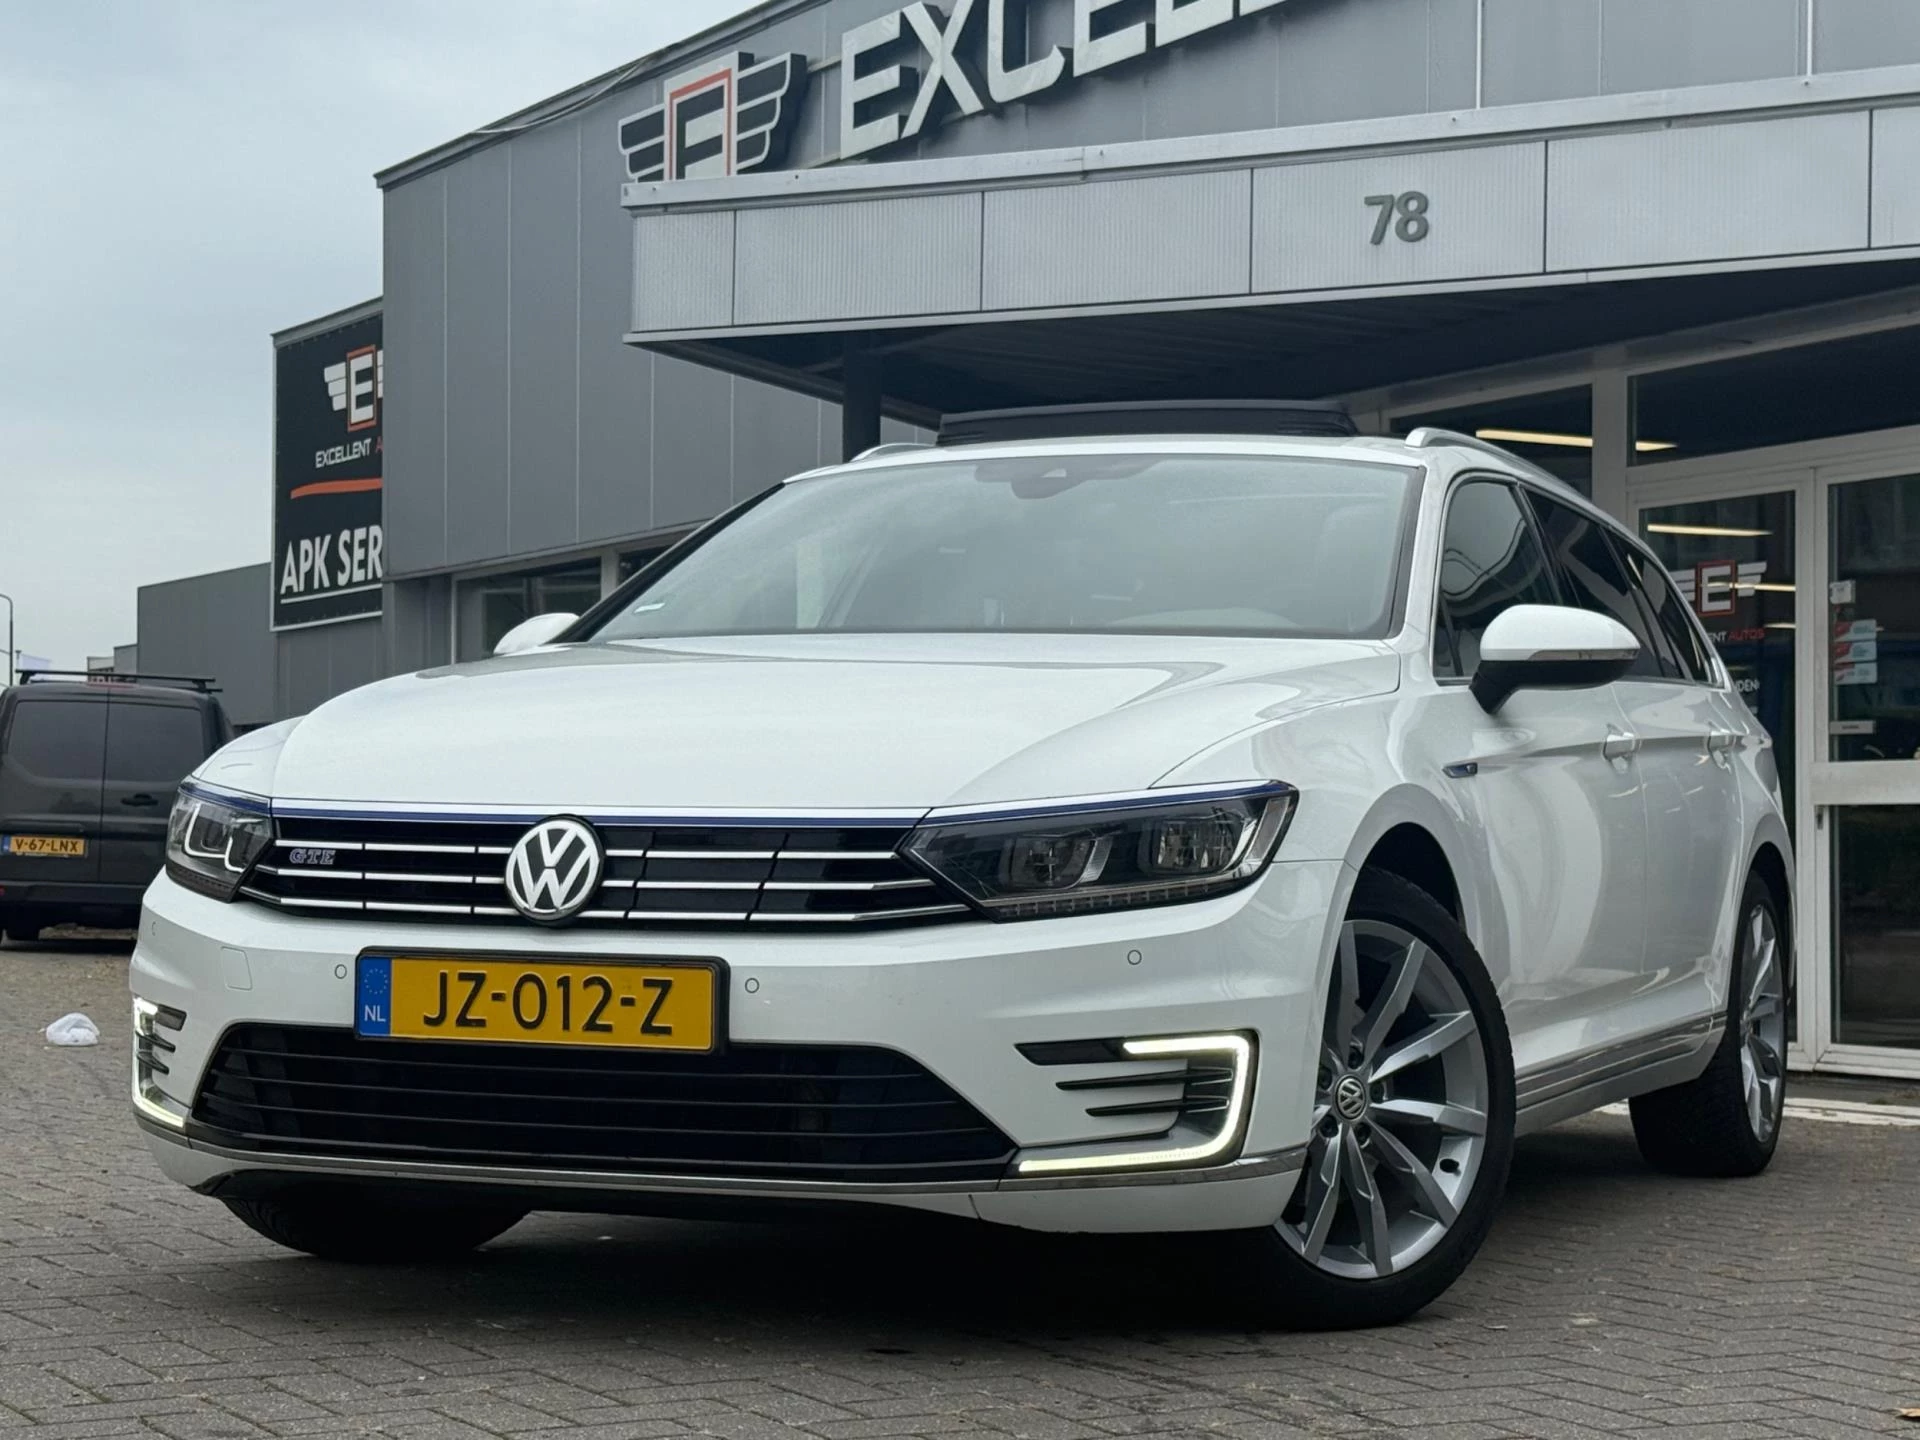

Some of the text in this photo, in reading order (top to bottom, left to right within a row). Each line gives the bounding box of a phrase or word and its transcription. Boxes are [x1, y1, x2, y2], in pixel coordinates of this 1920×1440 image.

[1364, 190, 1429, 245] 78
[315, 437, 372, 469] EXCELLENT
[280, 533, 332, 595] APK
[1728, 628, 1765, 641] AUTOS
[15, 838, 78, 853] V-67-LNX
[290, 848, 336, 865] GTE
[364, 1005, 386, 1022] NL
[423, 971, 674, 1035] JZ-012-Z
